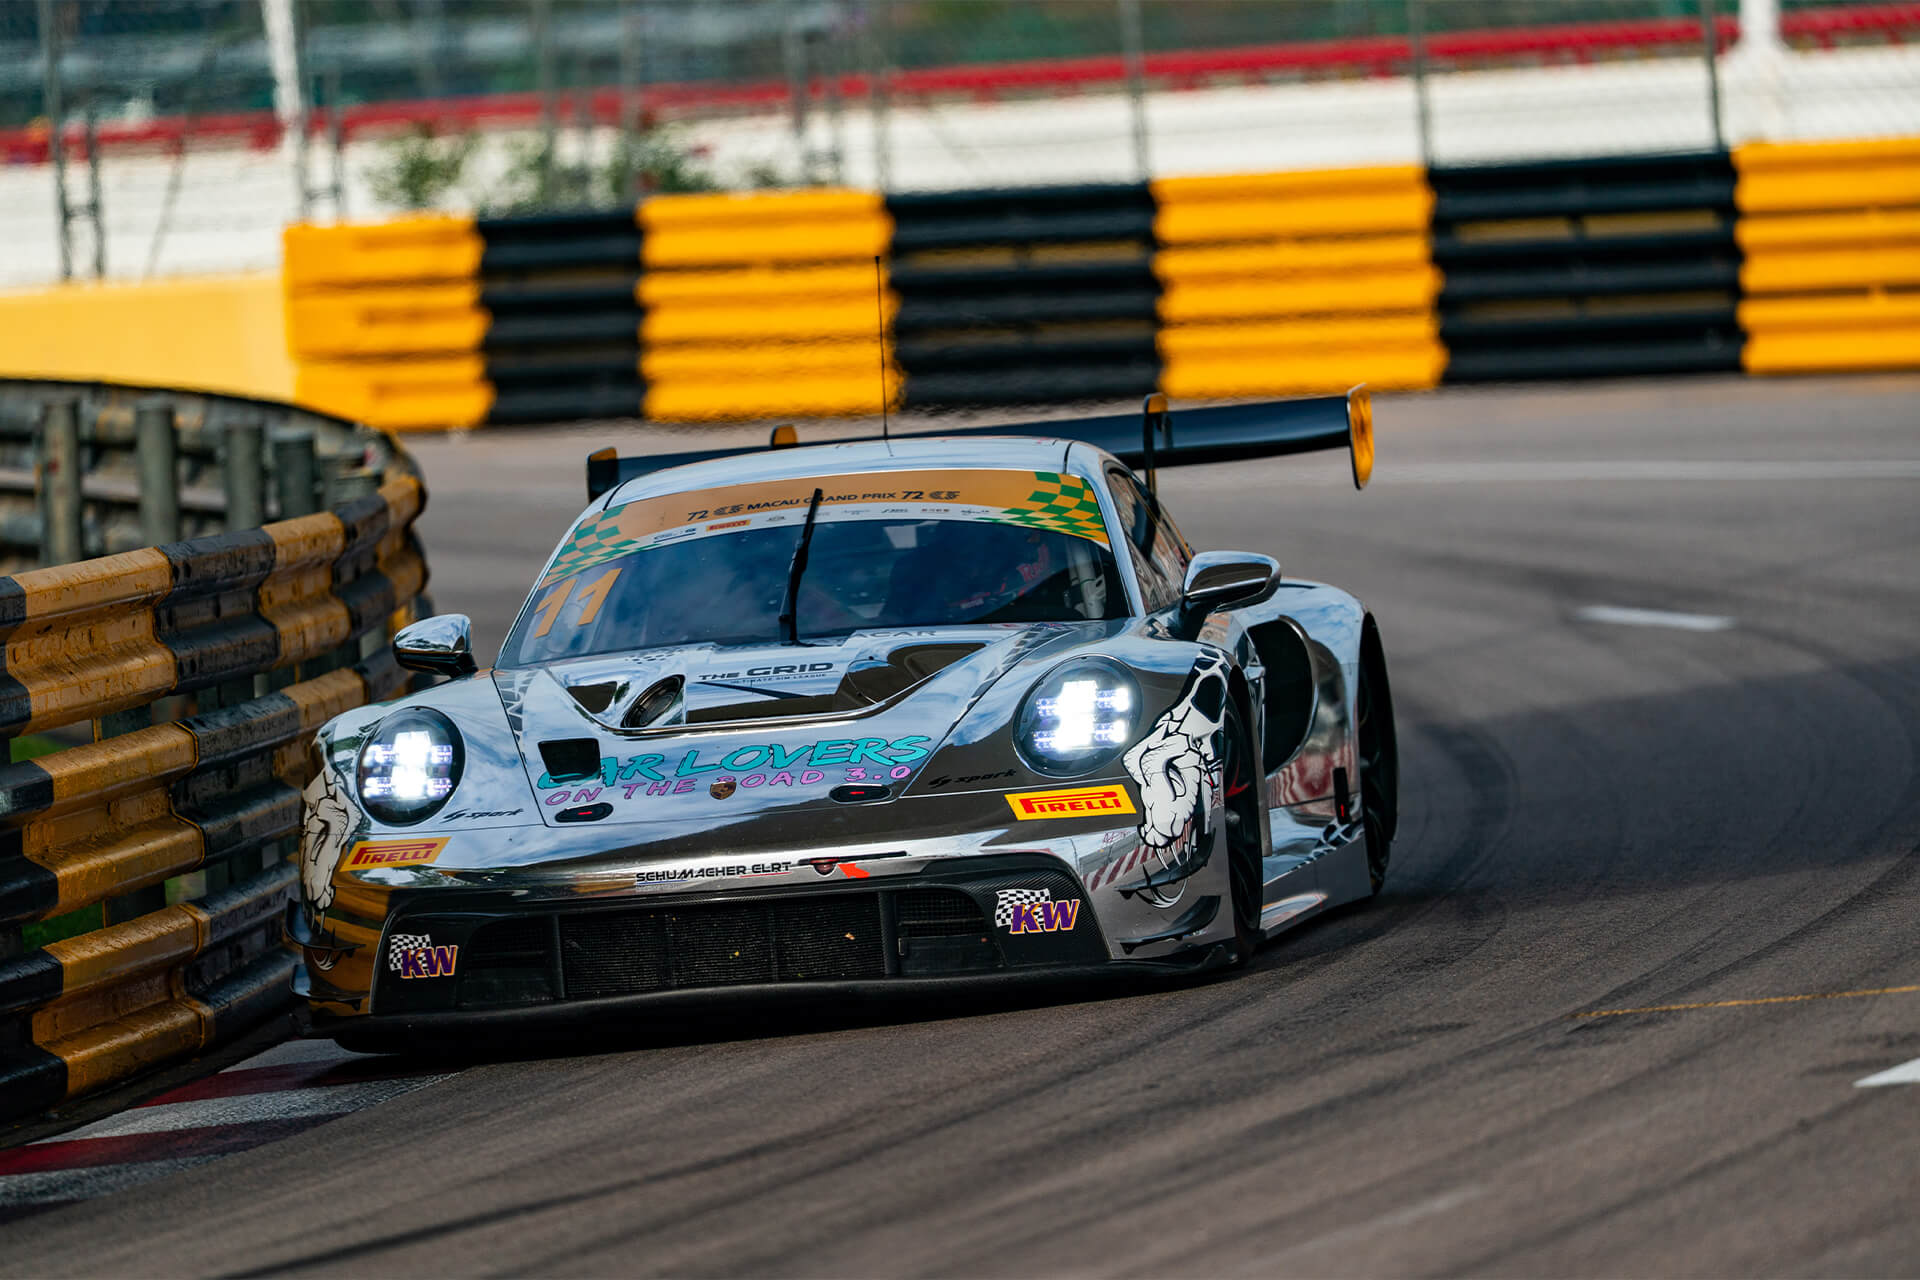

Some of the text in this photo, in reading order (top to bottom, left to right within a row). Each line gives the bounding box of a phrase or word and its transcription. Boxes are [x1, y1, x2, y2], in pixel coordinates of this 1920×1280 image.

[687, 490, 924, 522] 72 MACAU GAND PRIX 72
[534, 567, 623, 639] 11
[698, 662, 834, 681] THE GRID
[674, 735, 932, 777] LOVERS
[544, 787, 602, 806] ON
[622, 778, 698, 800] THE
[845, 765, 912, 782] 3.0
[1019, 791, 1122, 814] PIRELLI
[351, 842, 438, 865] PIRELLI
[1009, 898, 1080, 935] KW
[400, 944, 459, 979] KW
